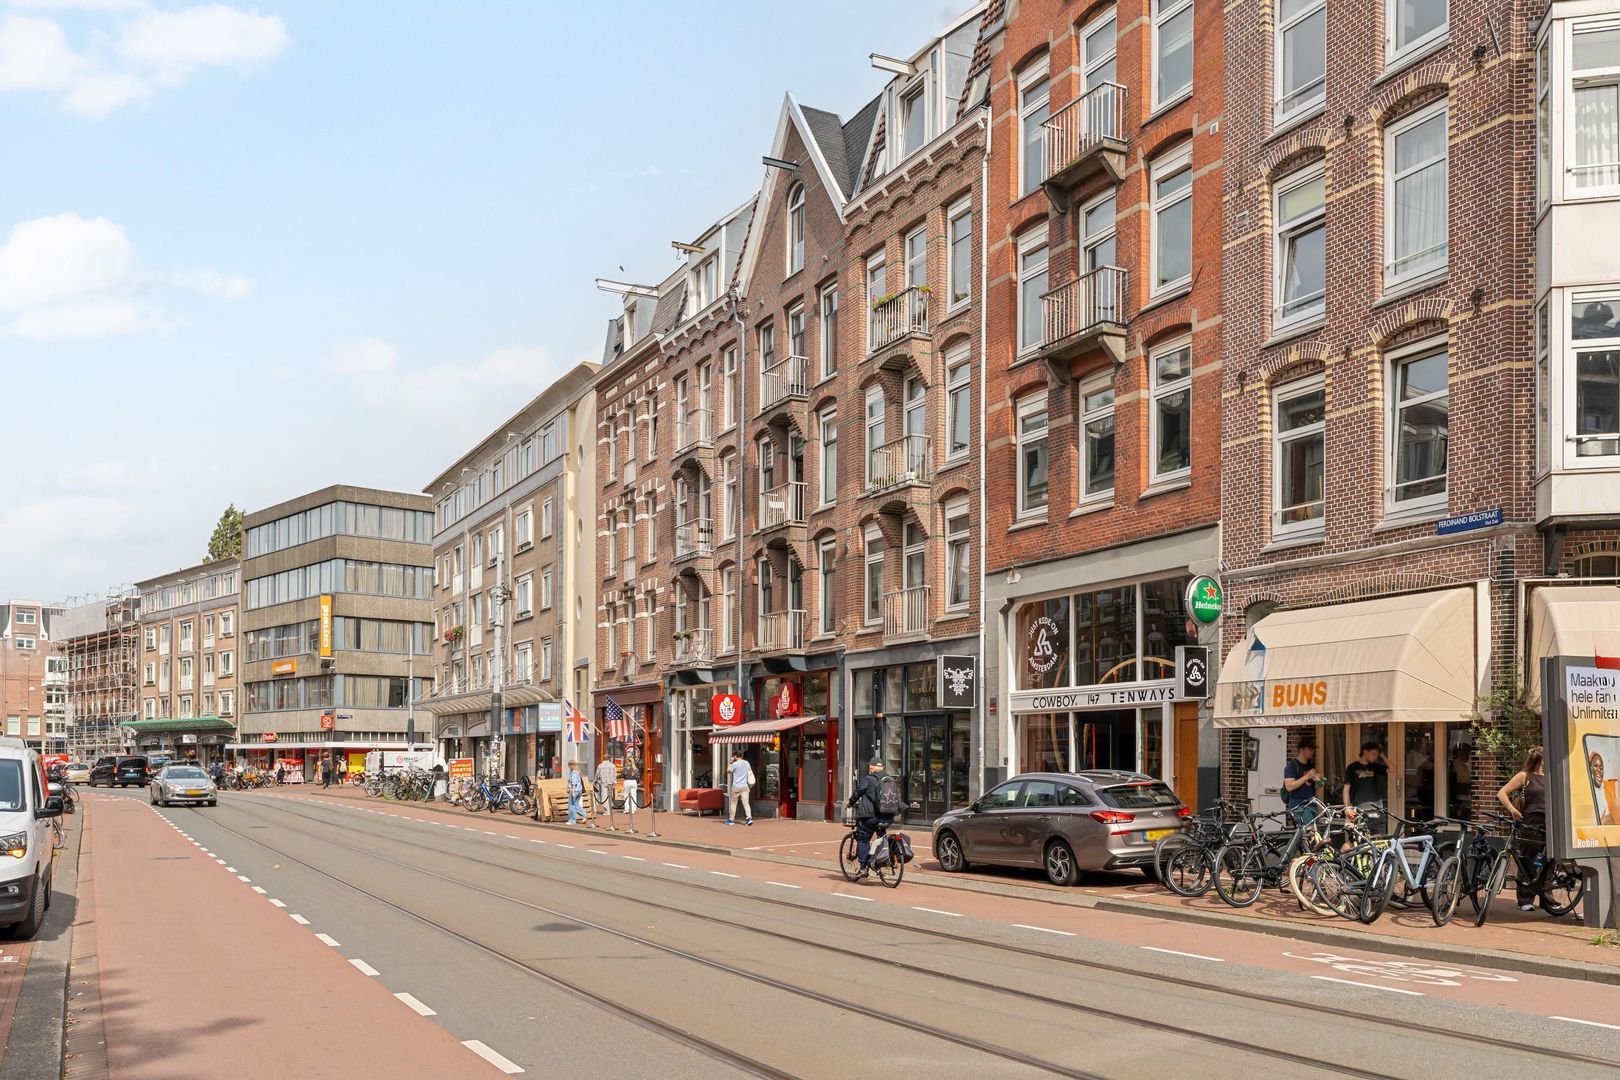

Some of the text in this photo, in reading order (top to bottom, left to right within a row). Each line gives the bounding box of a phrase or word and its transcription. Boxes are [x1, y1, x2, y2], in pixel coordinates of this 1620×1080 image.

[1438, 511, 1498, 528] FERDINAND BOLSTRAAT
[1028, 616, 1059, 639] JUST RIDE ON
[1028, 652, 1059, 672] AMSTERDAM
[1570, 673, 1599, 687] Maak
[1087, 694, 1100, 705] 147
[1110, 688, 1175, 704] TENWAYS
[1273, 681, 1327, 707] BUNS
[1571, 690, 1594, 703] hele
[1255, 713, 1341, 725] YOUR ALL DAY HANGOUT
